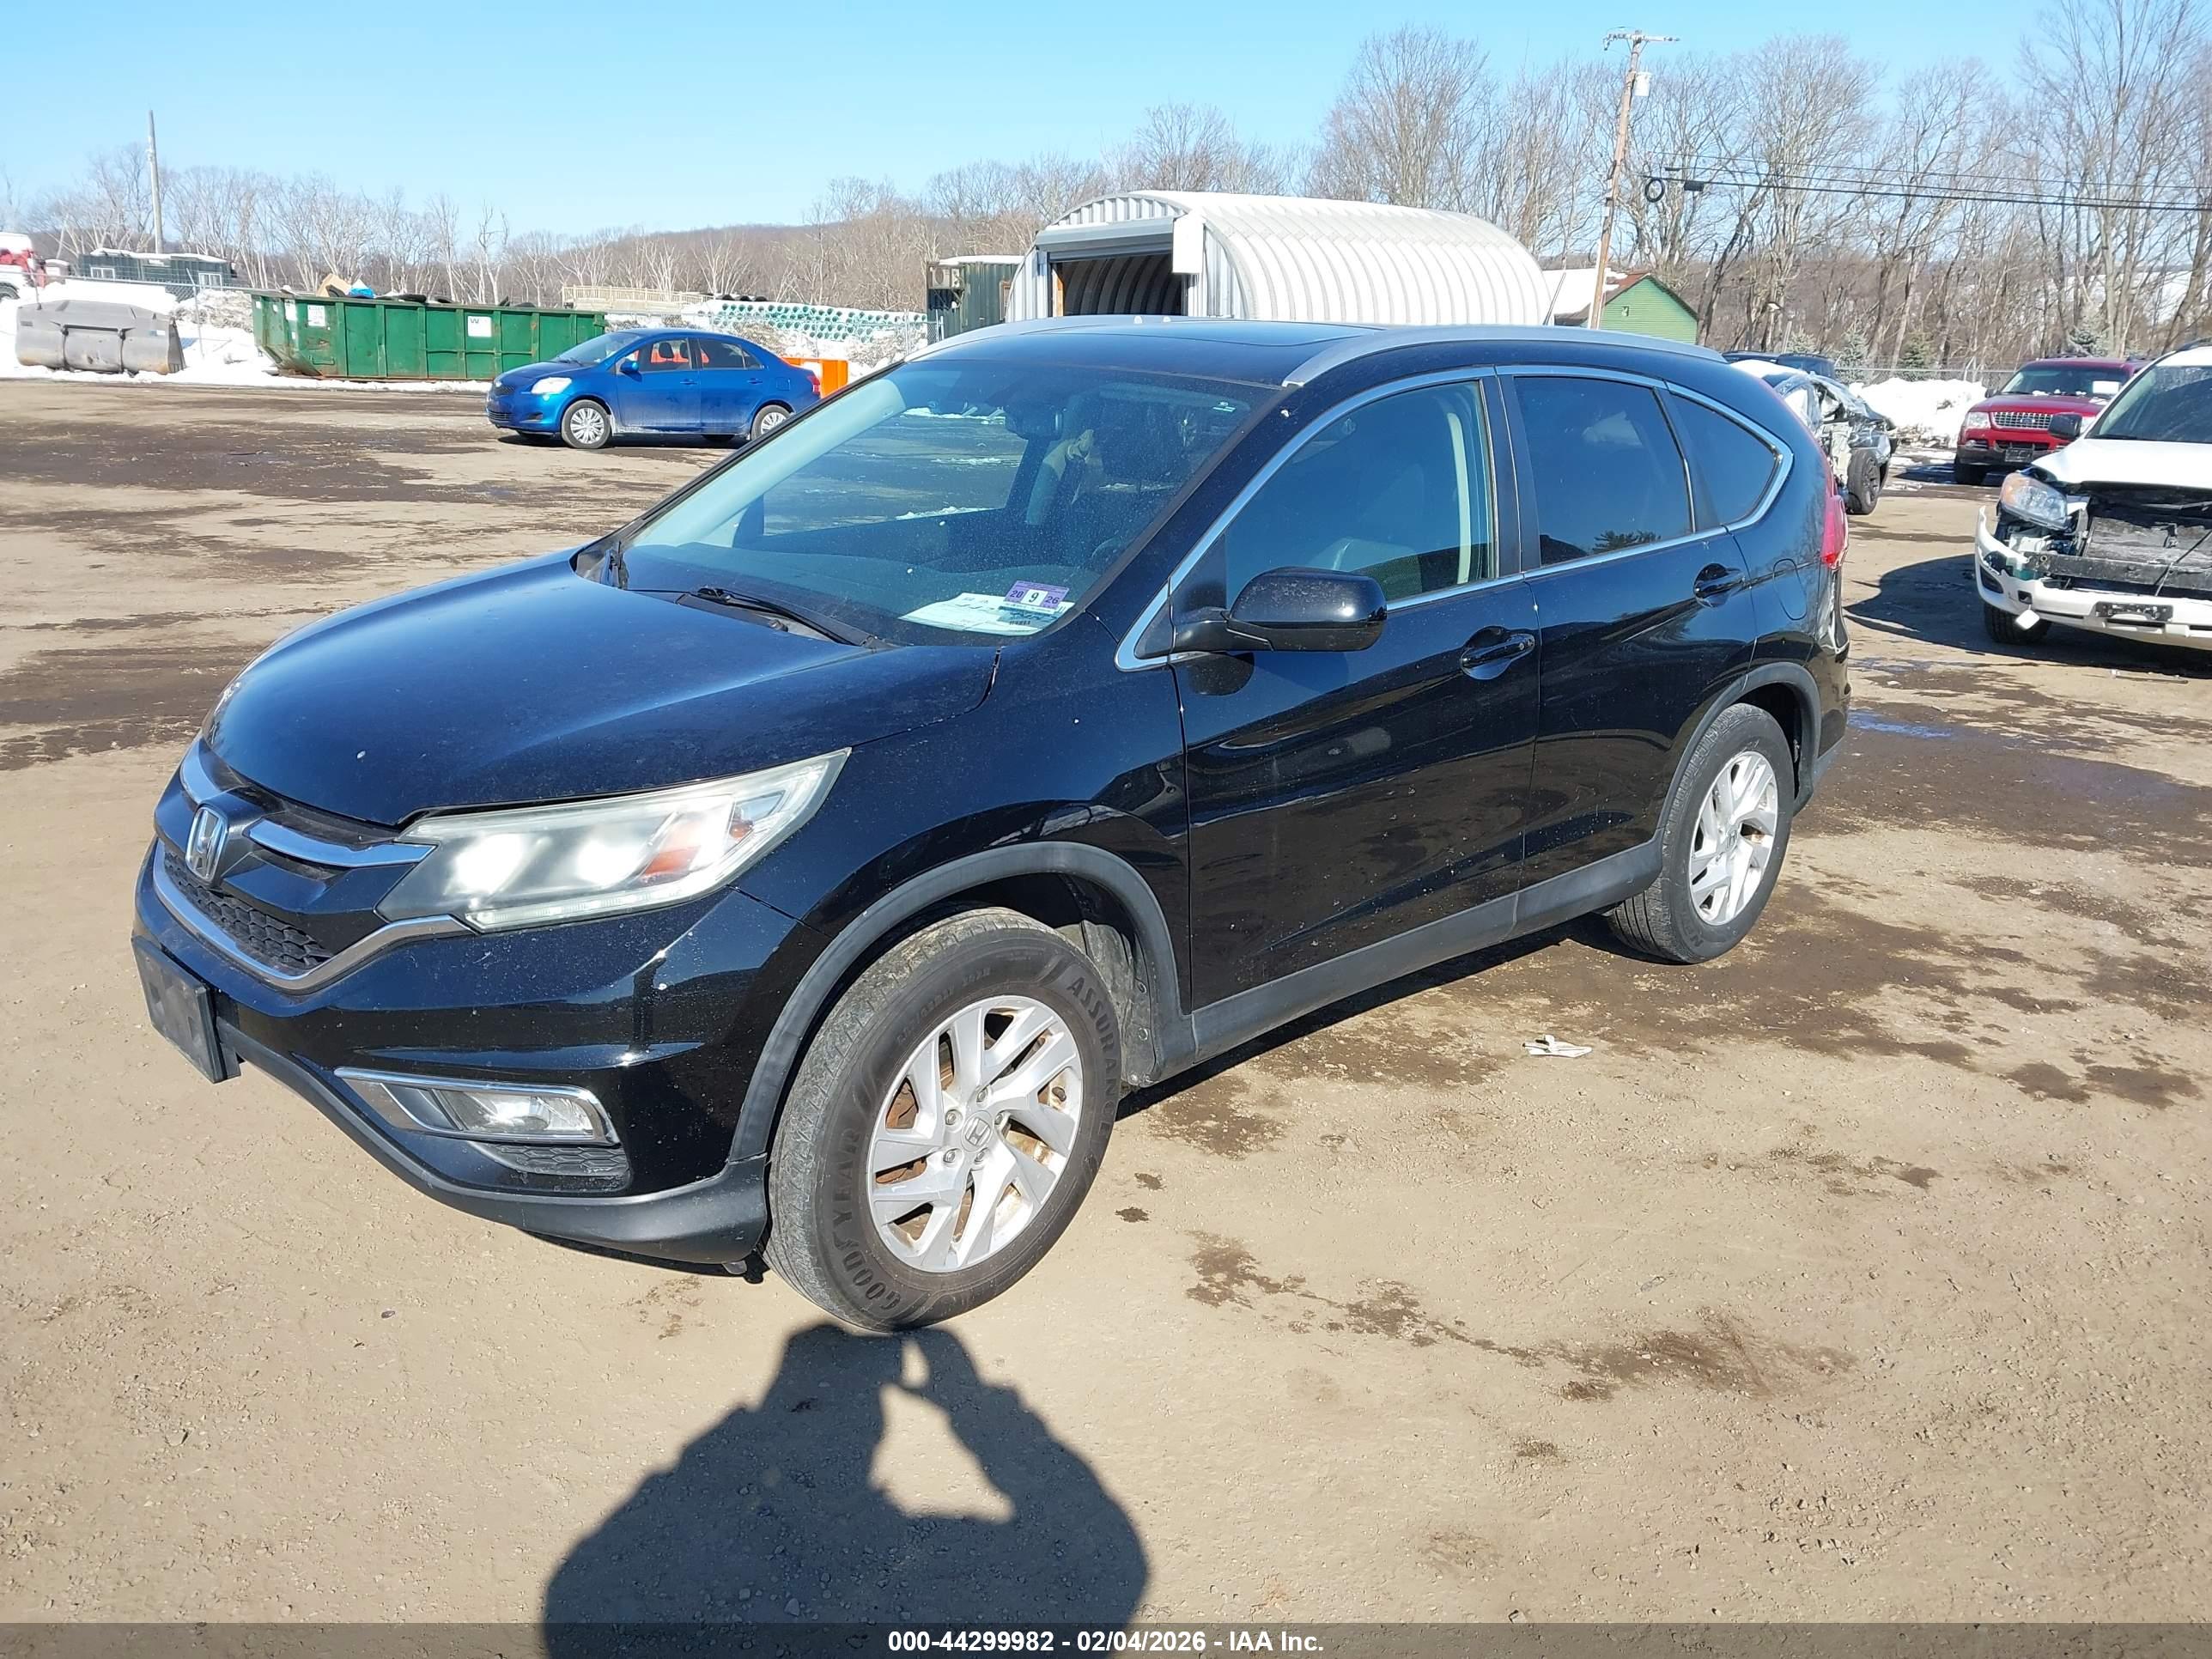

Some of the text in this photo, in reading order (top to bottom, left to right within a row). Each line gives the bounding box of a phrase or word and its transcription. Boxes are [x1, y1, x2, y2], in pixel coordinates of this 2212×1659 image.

[1010, 590, 1060, 605] 20 9 26
[1066, 976, 1116, 1136] ASSURANCE
